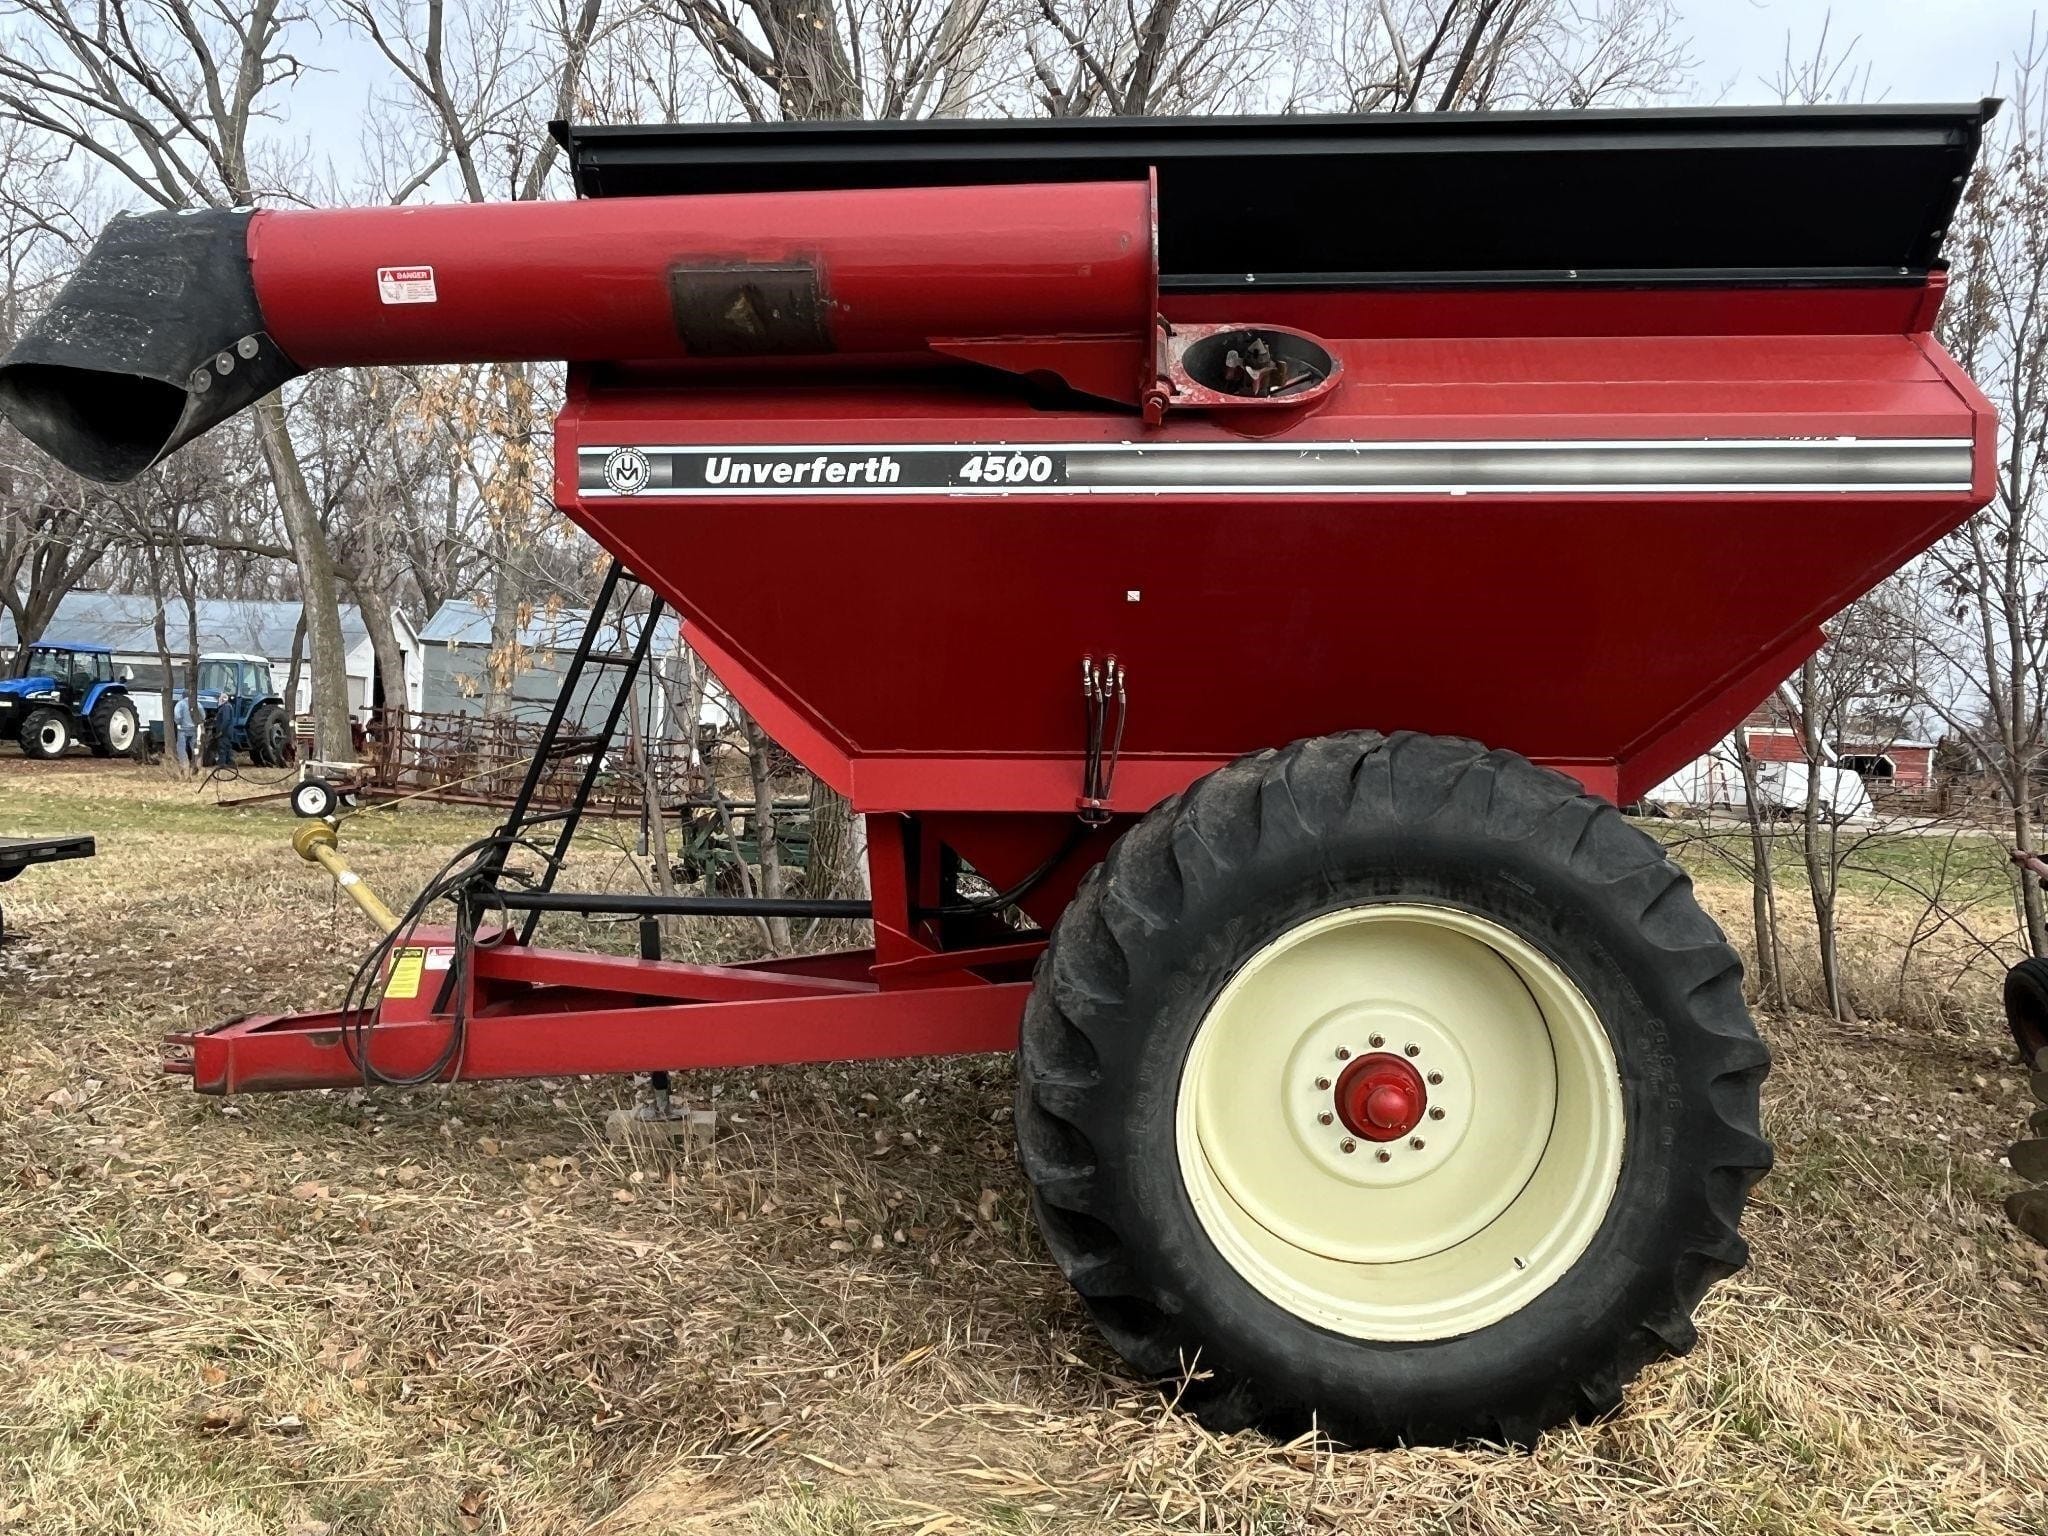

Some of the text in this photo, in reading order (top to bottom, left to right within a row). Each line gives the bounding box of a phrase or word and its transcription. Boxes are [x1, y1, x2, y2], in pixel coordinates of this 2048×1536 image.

[396, 271, 428, 280] DANGER
[704, 455, 1053, 484] Unverferth 4500
